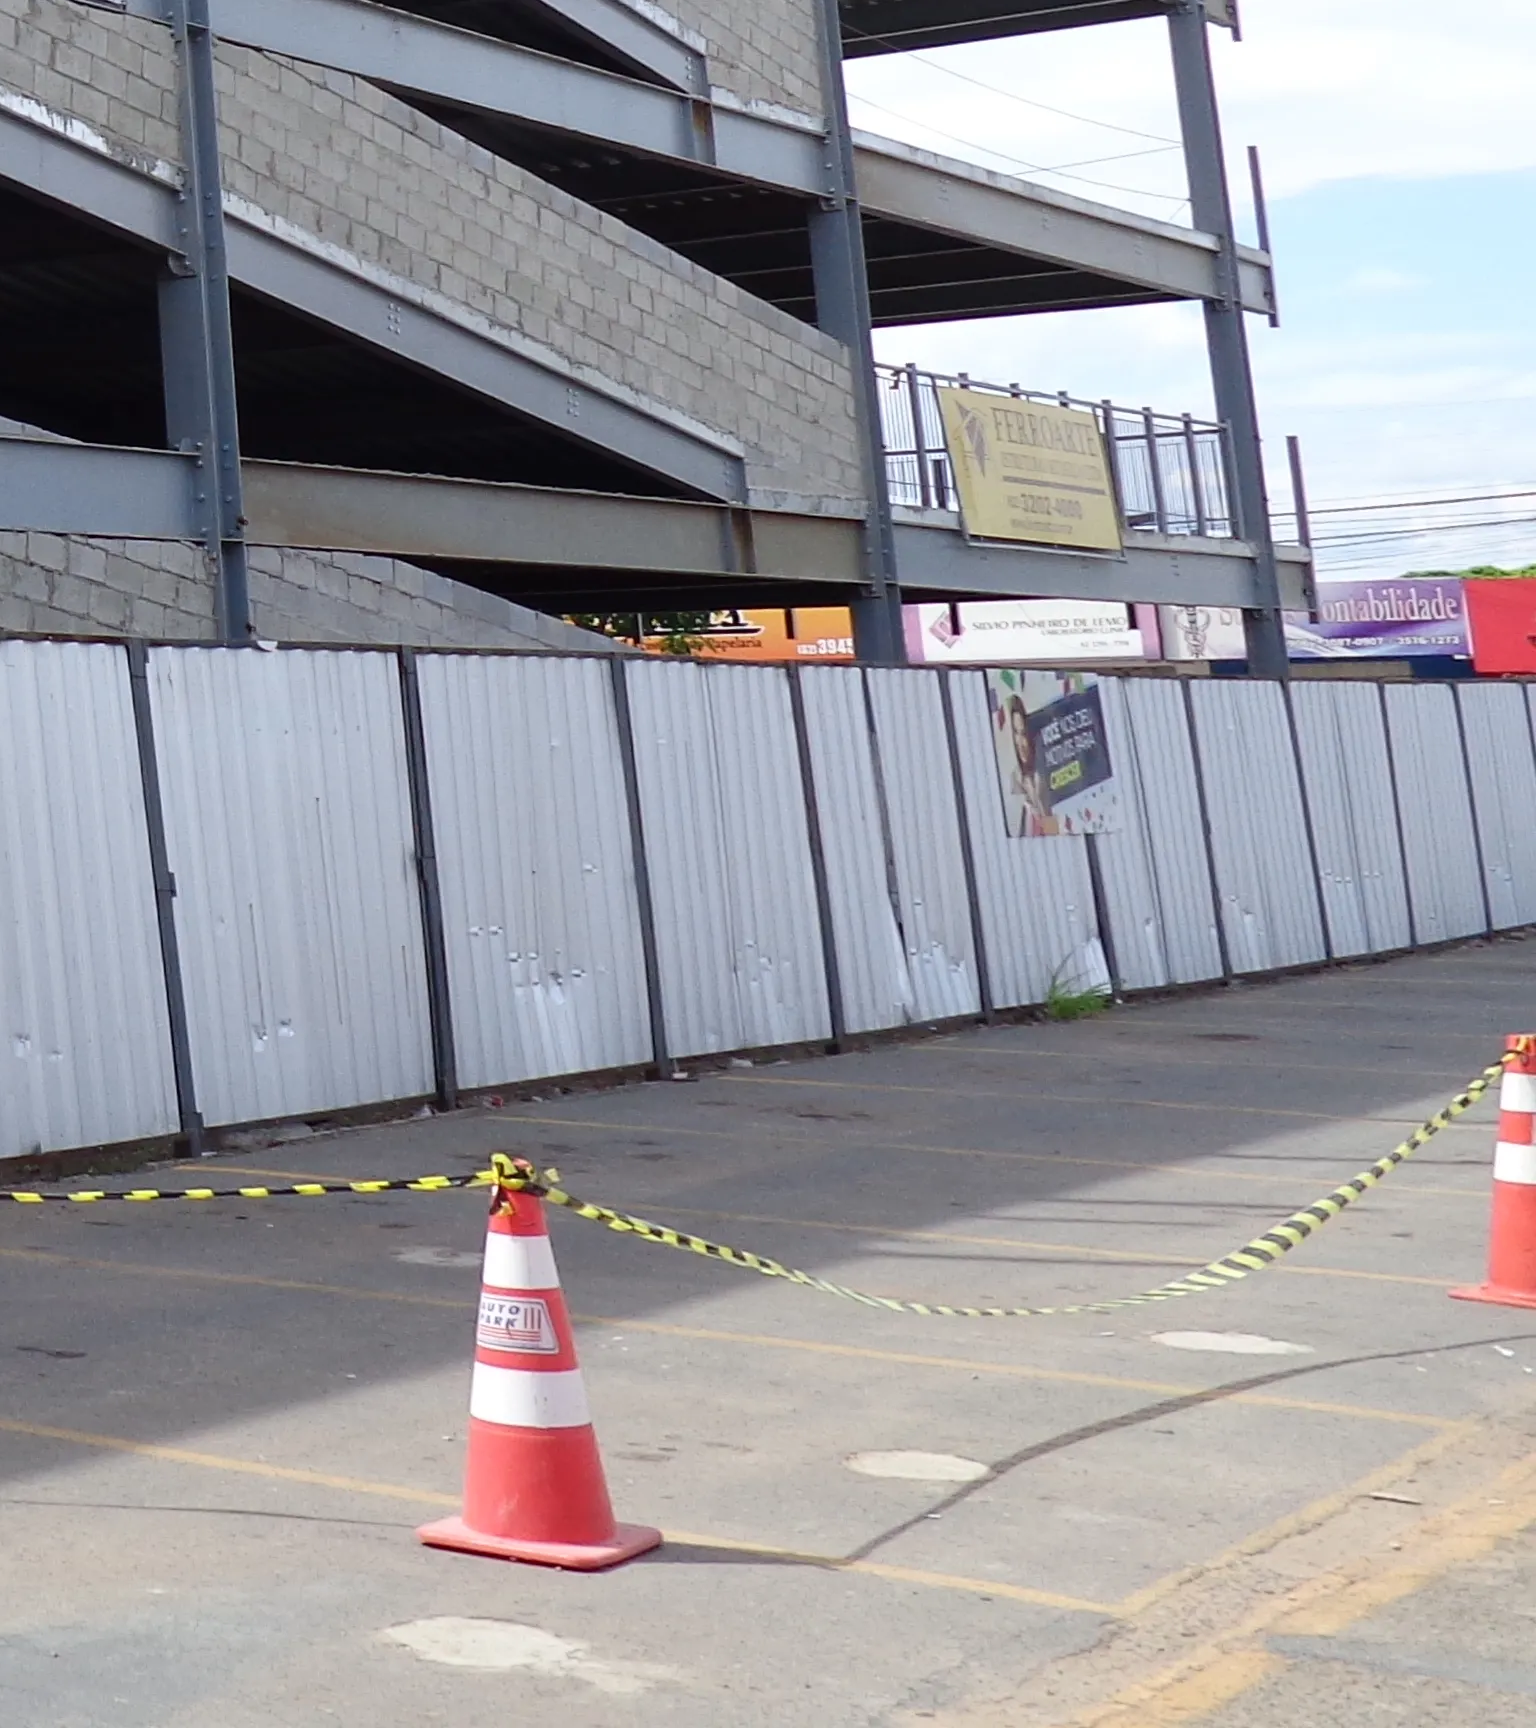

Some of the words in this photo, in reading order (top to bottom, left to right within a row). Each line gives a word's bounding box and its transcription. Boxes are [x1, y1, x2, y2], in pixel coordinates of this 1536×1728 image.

[990, 406, 1100, 457] FERROARTE
[1092, 615, 1127, 627] LEMO
[1321, 586, 1459, 623] ontabilidade
